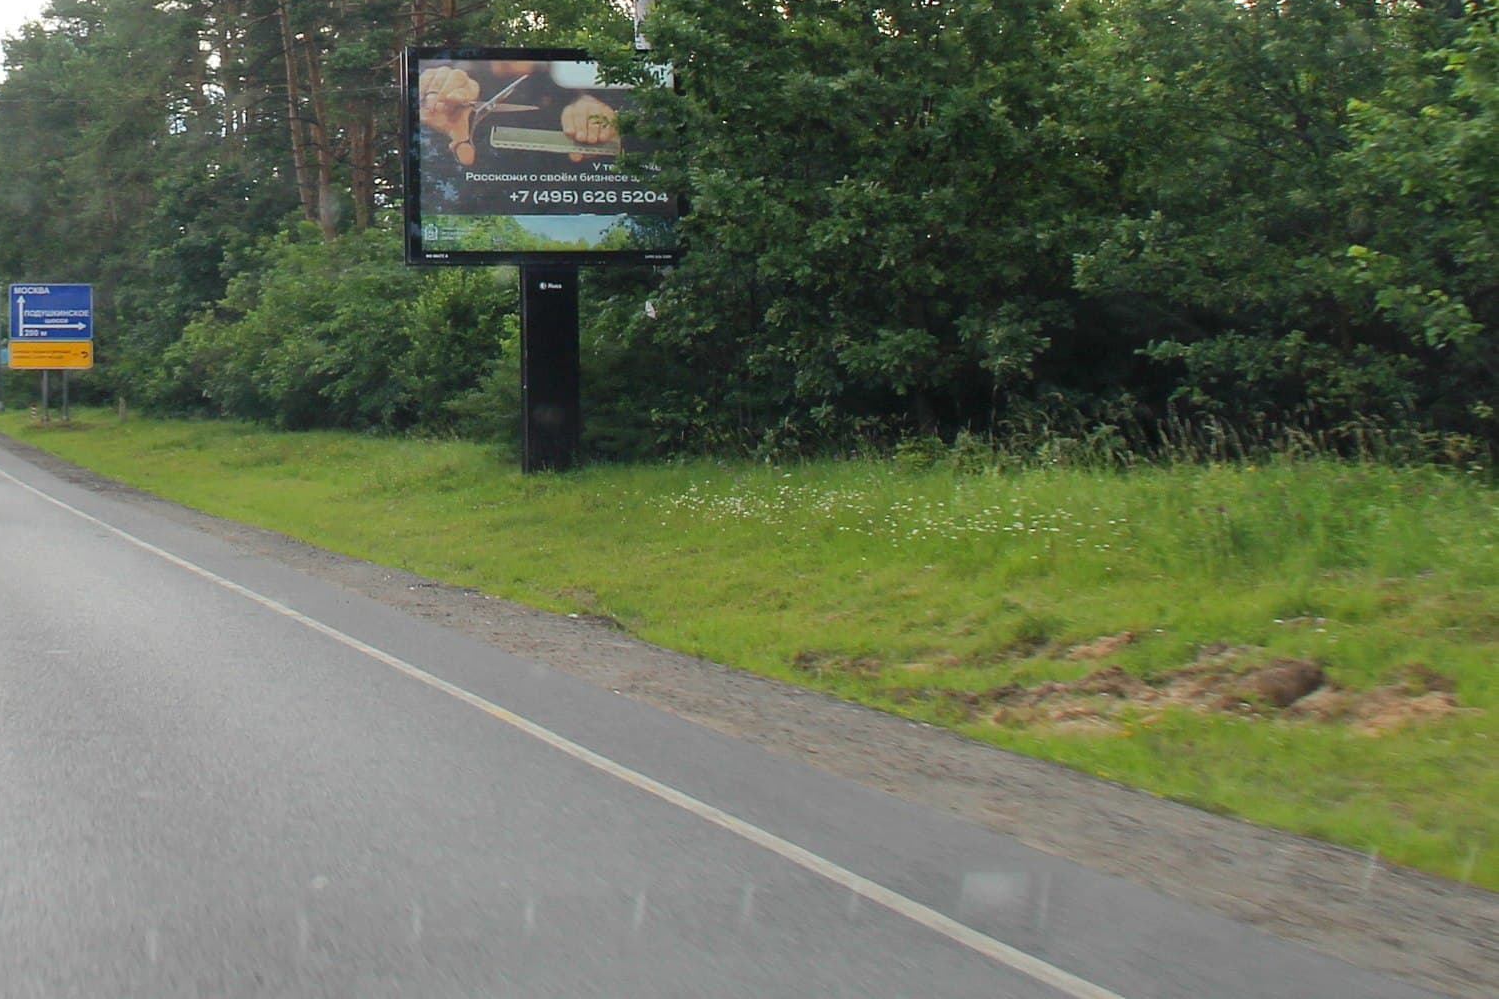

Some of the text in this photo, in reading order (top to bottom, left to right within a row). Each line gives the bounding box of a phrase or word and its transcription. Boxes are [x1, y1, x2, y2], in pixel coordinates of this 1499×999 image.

[465, 171, 527, 182] Расскажи
[529, 173, 538, 182] о
[539, 172, 578, 182] своём
[579, 172, 629, 183] бизнесе
[509, 190, 669, 204] +7 (495) 626 5204
